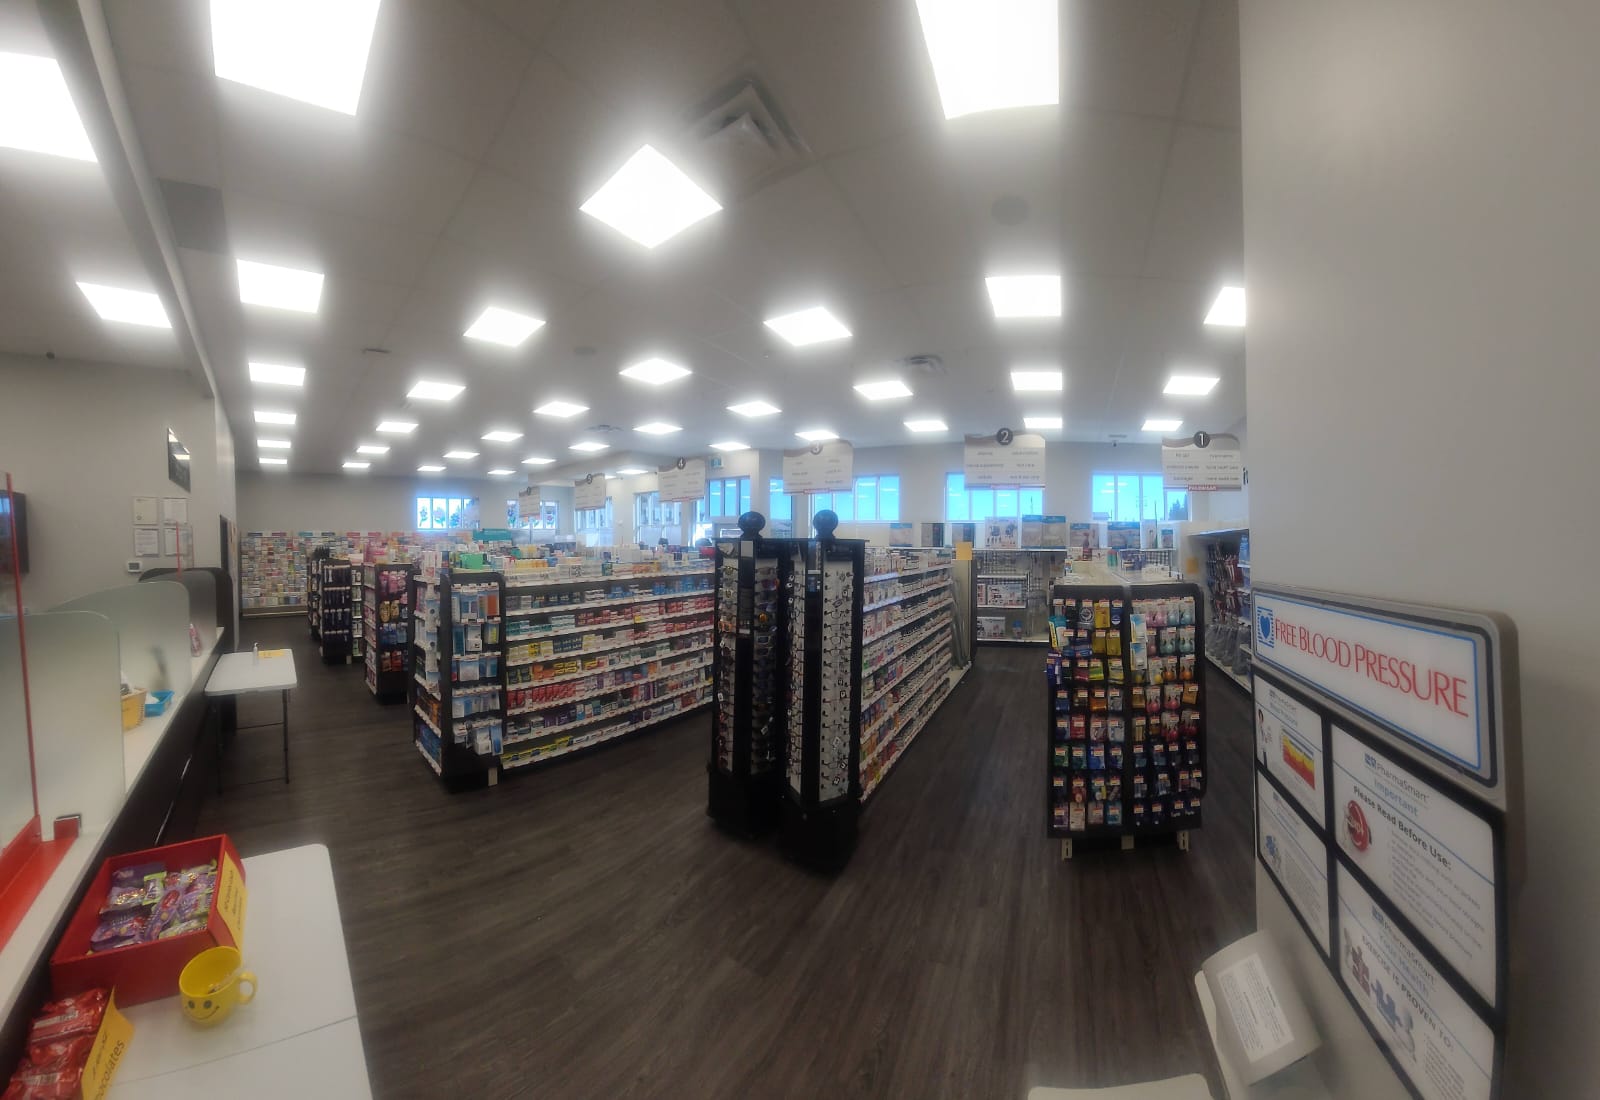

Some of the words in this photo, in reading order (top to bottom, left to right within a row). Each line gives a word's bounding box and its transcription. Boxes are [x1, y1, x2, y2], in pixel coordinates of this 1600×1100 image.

[999, 431, 1010, 444] 2
[1275, 618, 1297, 649] FREE
[1299, 627, 1351, 669] BLOOD
[1355, 644, 1469, 718] PRESSURE
[1374, 779, 1419, 817] Important
[1376, 762, 1430, 801] PharmaSmart
[1353, 785, 1376, 809] Please
[1377, 803, 1397, 825] Read
[1398, 820, 1429, 851] Before
[1429, 845, 1452, 871] Use:
[1393, 972, 1400, 986] IS
[1401, 983, 1436, 1031] PROVEN
